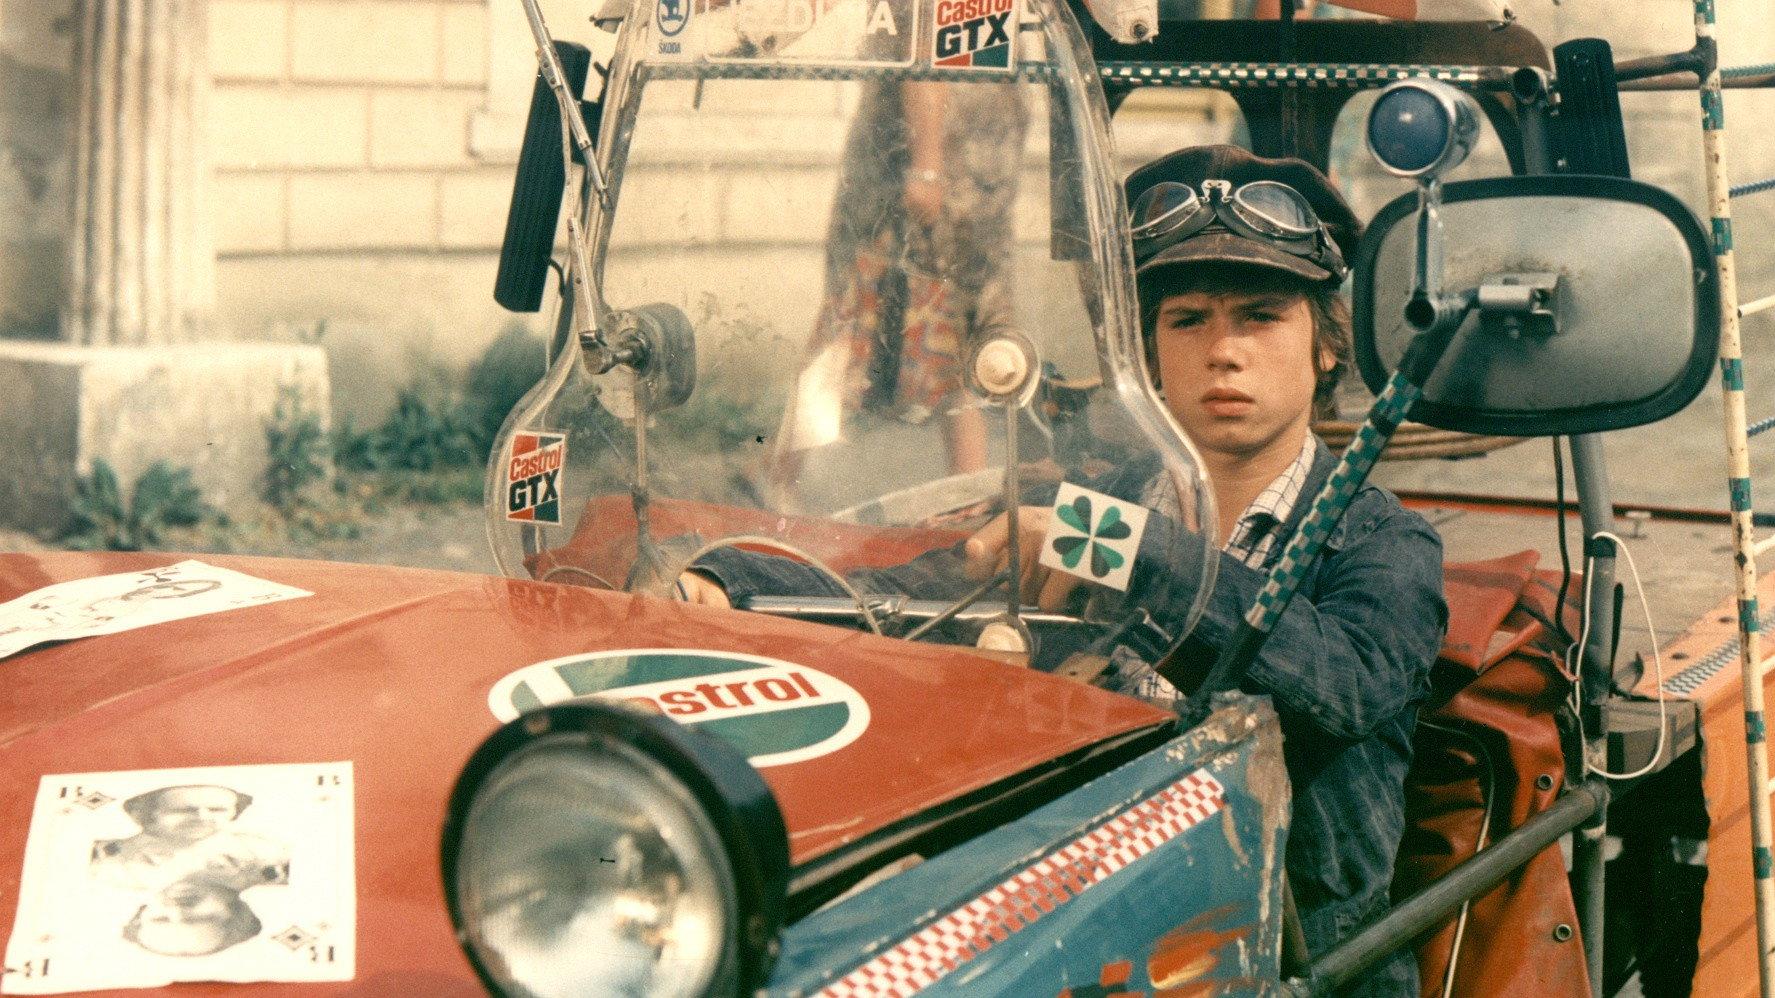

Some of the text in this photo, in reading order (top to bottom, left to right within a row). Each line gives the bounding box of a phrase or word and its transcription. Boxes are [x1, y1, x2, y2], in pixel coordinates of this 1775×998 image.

[936, 11, 1012, 59] GTX
[510, 444, 562, 481] Castrol
[509, 468, 560, 512] GTX
[632, 672, 820, 715] strol
